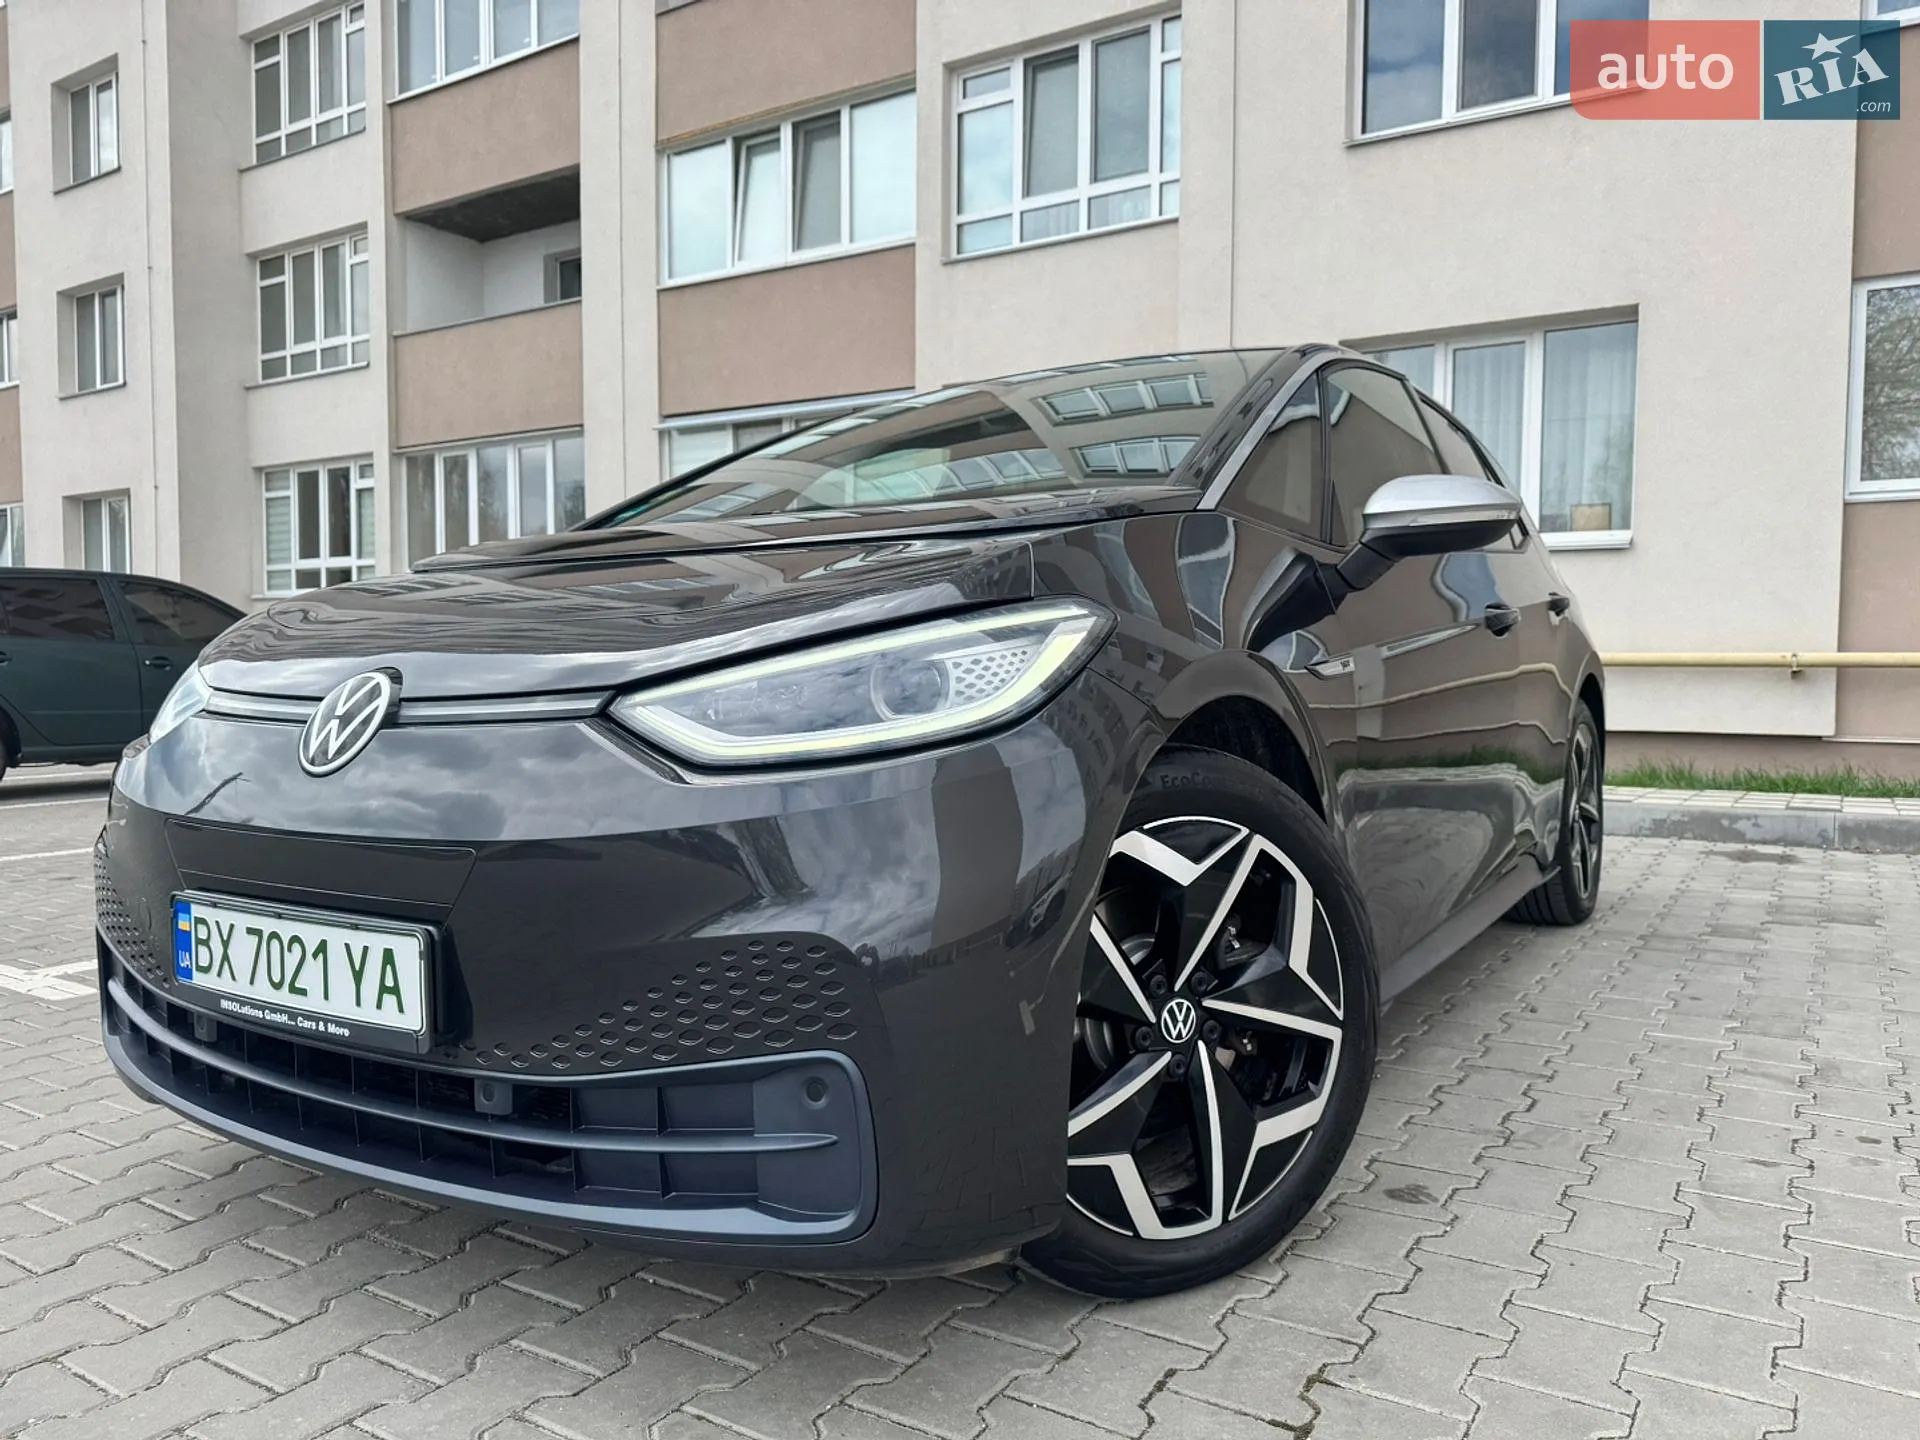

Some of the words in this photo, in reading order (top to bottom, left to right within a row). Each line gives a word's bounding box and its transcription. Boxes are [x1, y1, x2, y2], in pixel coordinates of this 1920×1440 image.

[178, 950, 191, 968] UA
[194, 916, 236, 982] BX
[246, 926, 329, 1001] 7021
[344, 942, 405, 1014] YA
[297, 1017, 316, 1030] Cars
[318, 1021, 325, 1032] &
[327, 1023, 350, 1036] More
